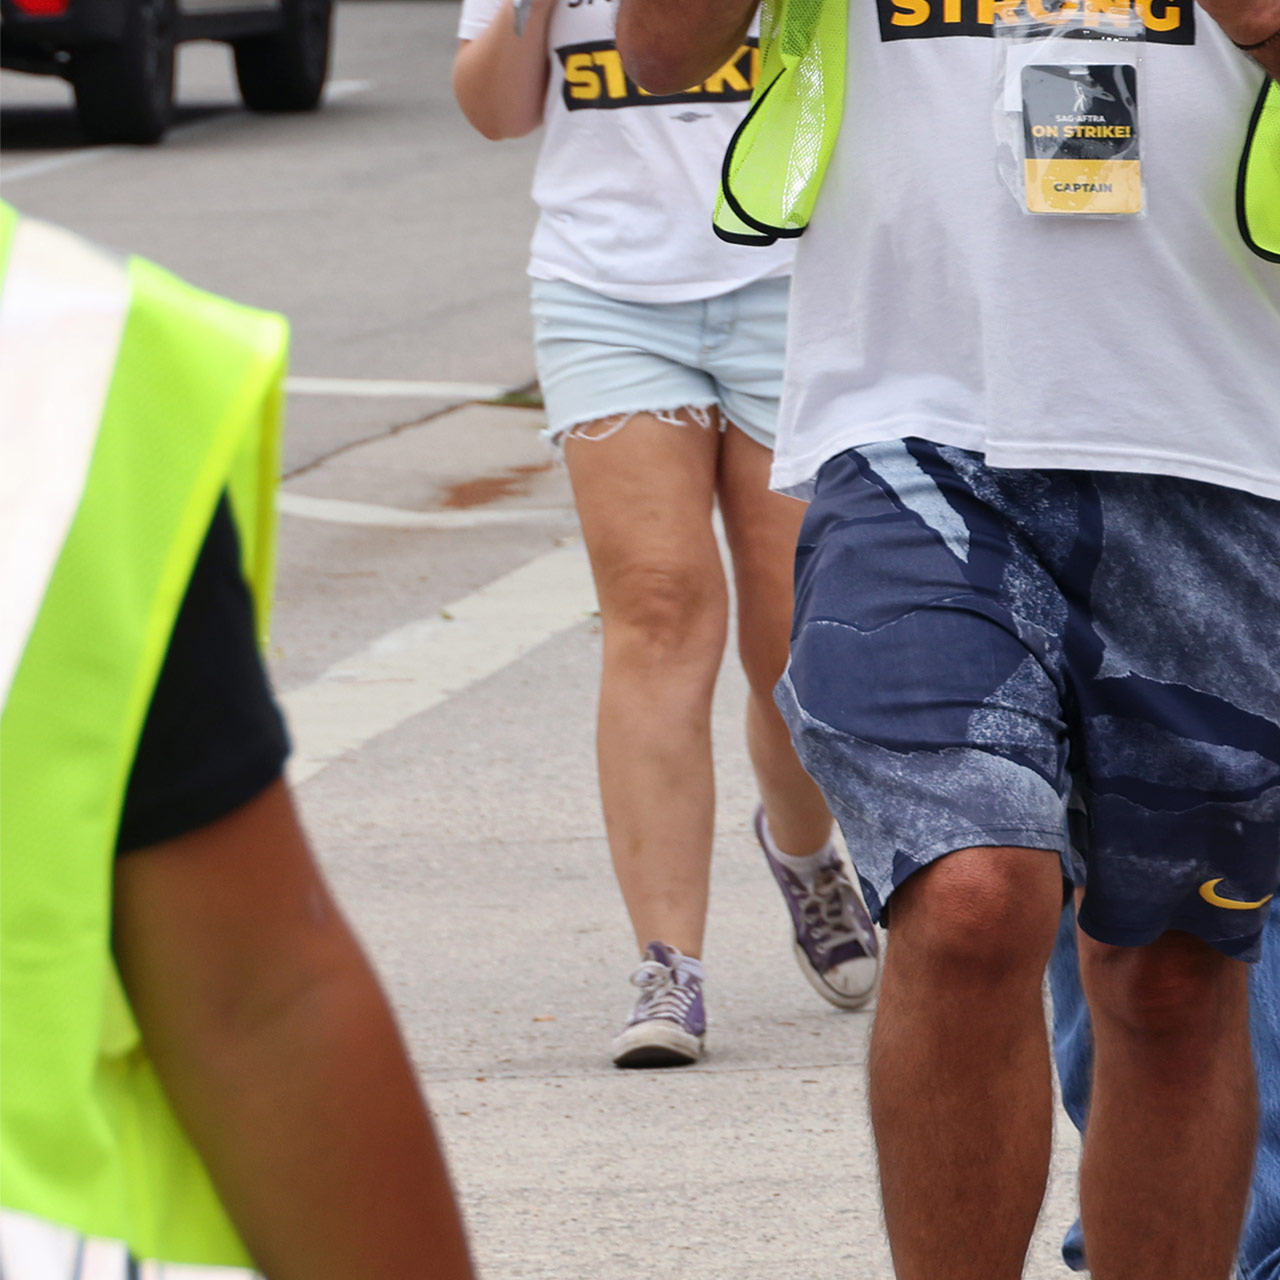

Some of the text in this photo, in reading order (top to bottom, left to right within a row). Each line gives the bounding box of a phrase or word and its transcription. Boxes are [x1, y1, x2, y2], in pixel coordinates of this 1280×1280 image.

[1031, 125, 1132, 139] ON STRIKE!
[1053, 182, 1113, 193] CAPTAIN
